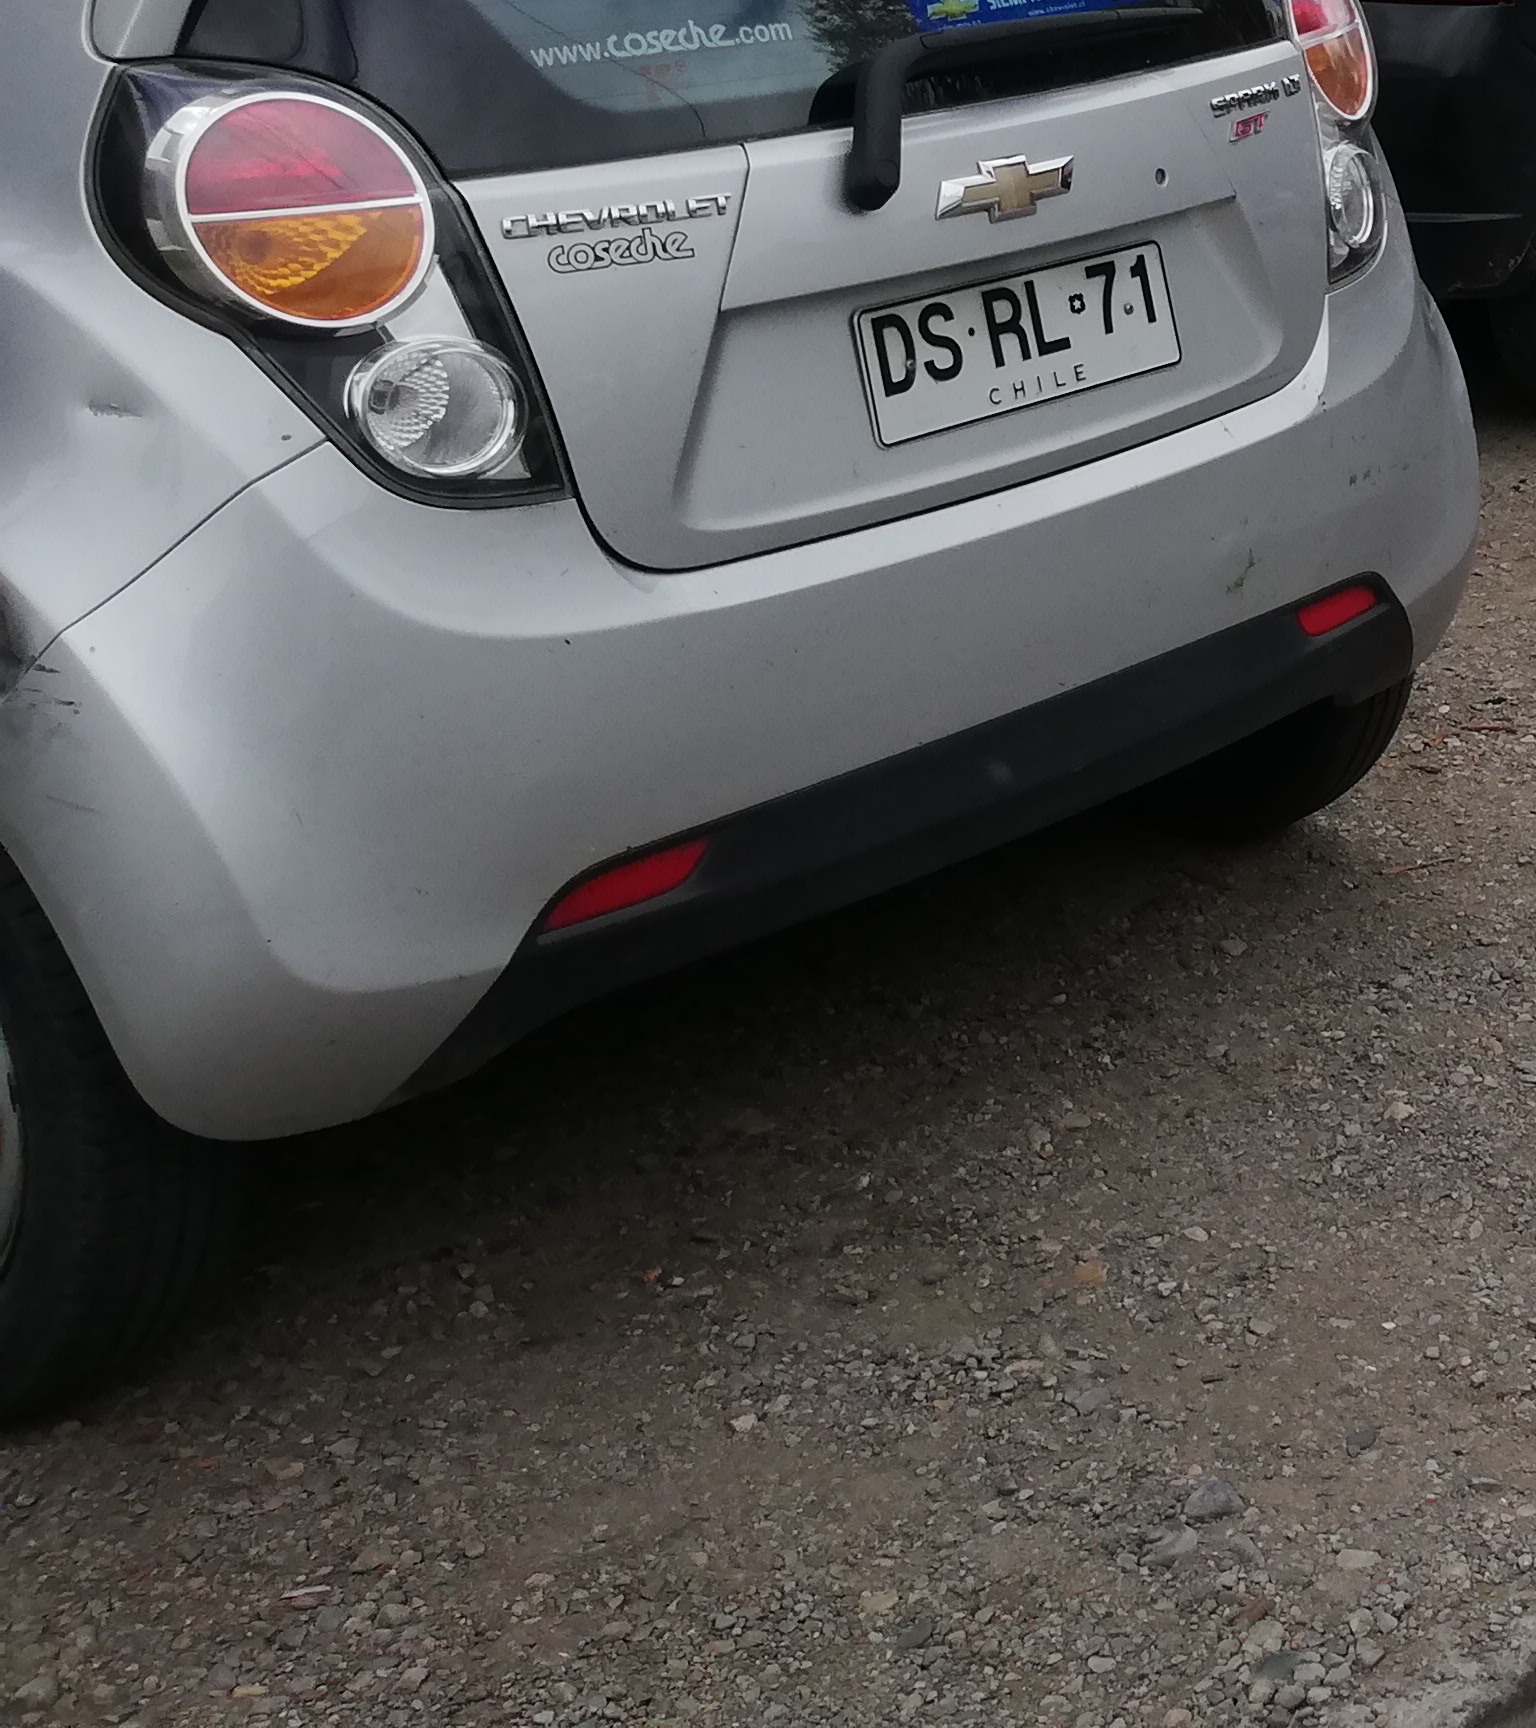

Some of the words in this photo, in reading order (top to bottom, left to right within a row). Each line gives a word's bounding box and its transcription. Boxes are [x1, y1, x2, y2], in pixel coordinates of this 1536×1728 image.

[530, 19, 793, 68] www.coseche.com
[501, 192, 732, 240] CHEVROLET
[547, 227, 695, 274] coseche
[988, 363, 1087, 405] CHILE
